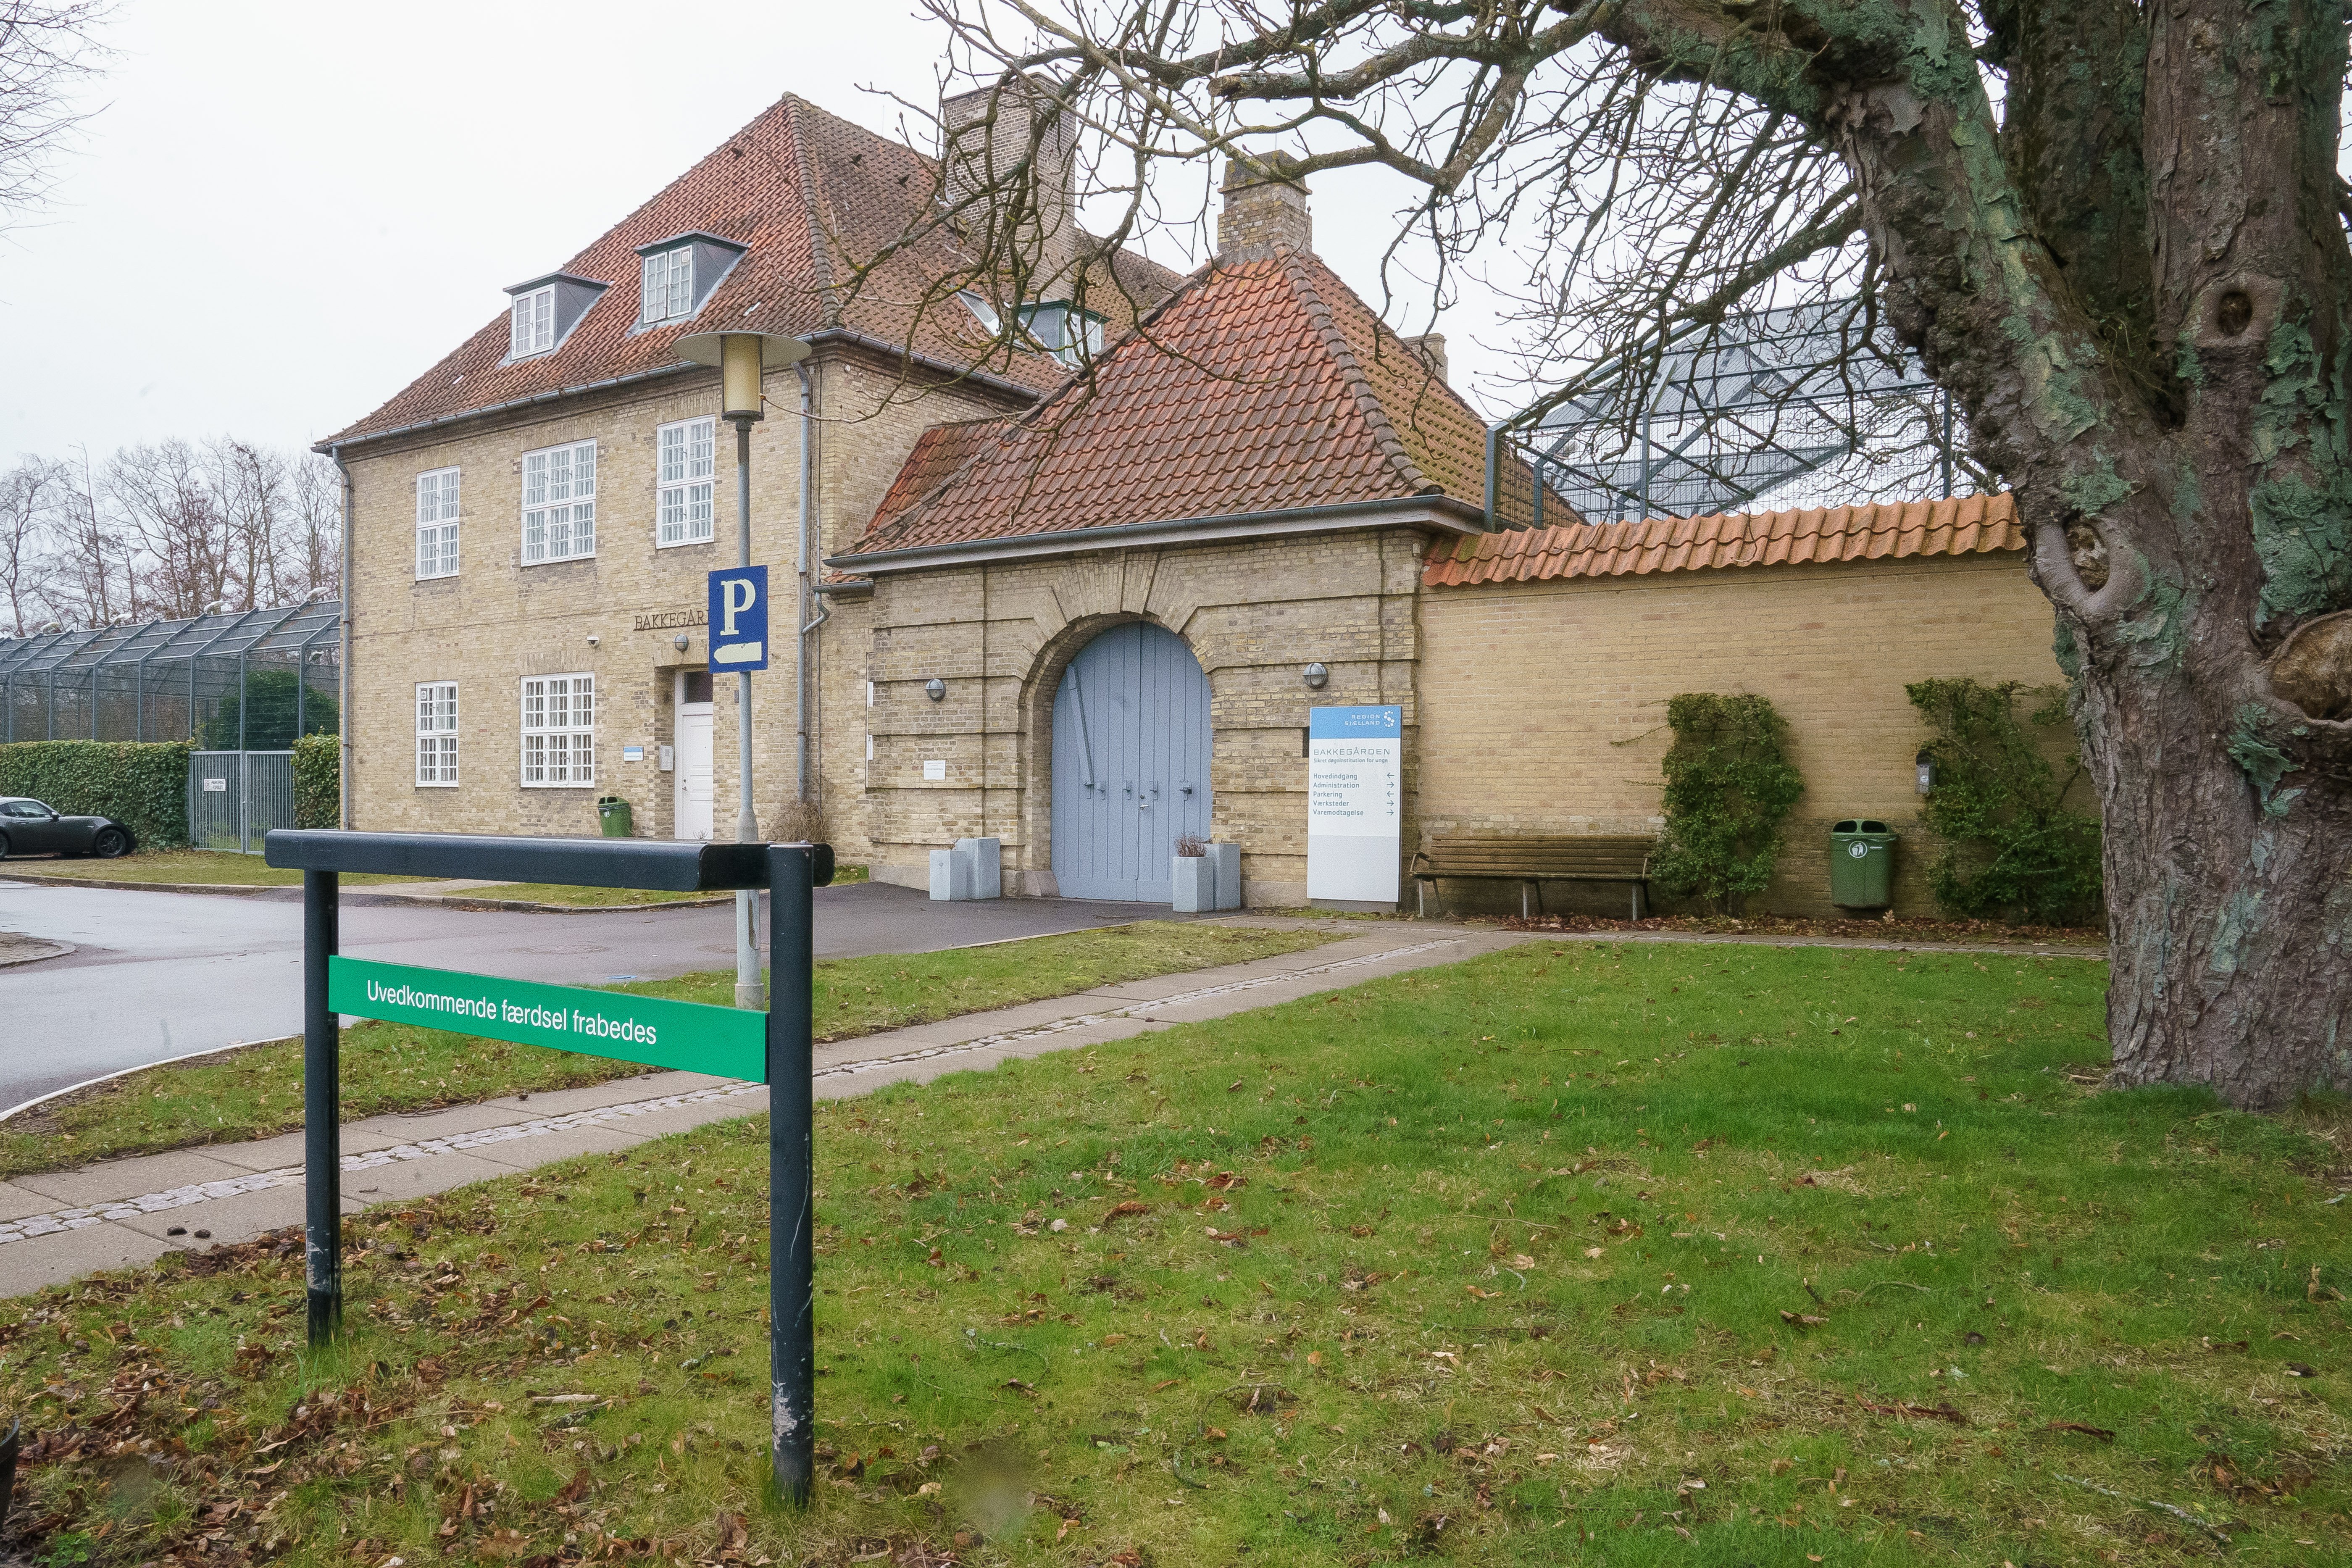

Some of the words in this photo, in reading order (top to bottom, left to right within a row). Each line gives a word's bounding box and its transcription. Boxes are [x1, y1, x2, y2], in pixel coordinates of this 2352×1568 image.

[720, 579, 756, 636] P
[1314, 747, 1390, 755] BAKKEGÅRDEN
[367, 979, 497, 1019] Uvedkommende
[501, 999, 567, 1031] færdsel
[572, 1010, 657, 1045] frabedes
